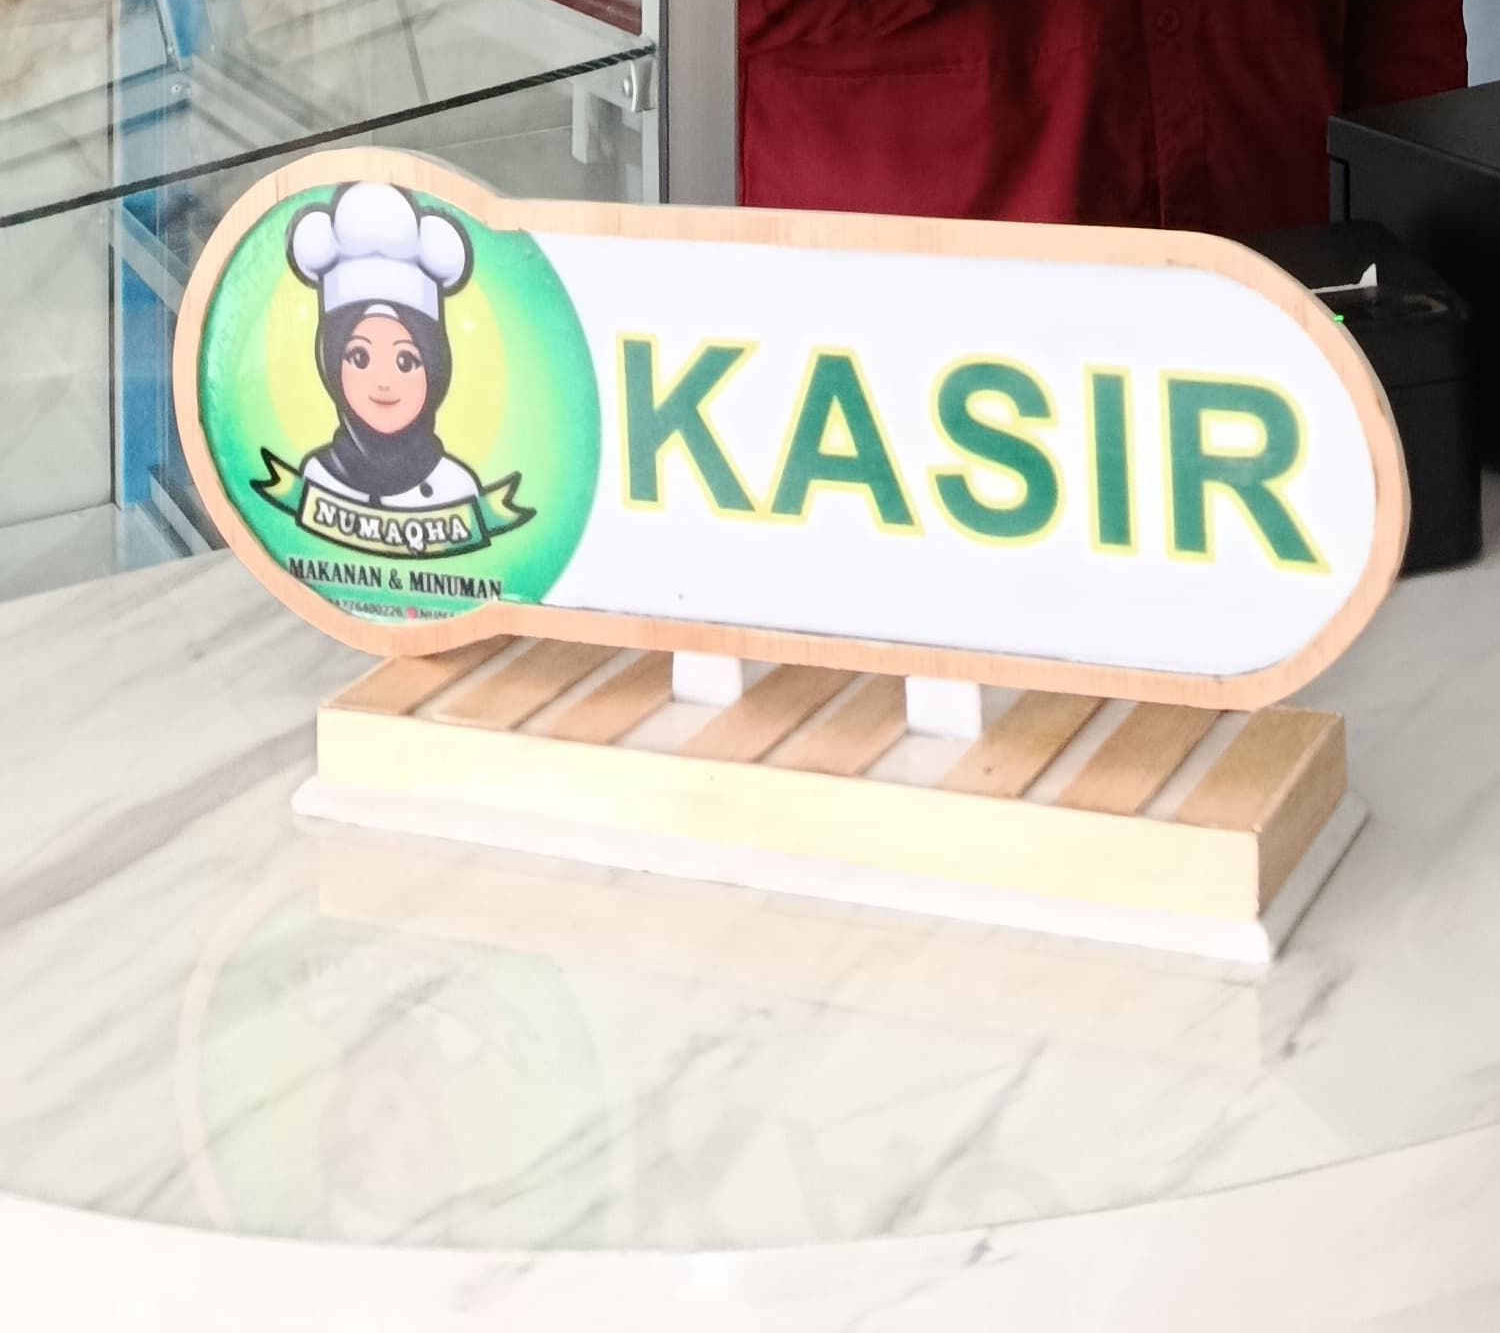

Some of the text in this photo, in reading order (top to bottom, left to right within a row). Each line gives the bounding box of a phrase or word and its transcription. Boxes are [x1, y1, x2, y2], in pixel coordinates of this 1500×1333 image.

[619, 334, 1327, 571] KASIR
[315, 499, 470, 552] NUMAQHA
[287, 556, 502, 600] MAKANAN & MINUMAN
